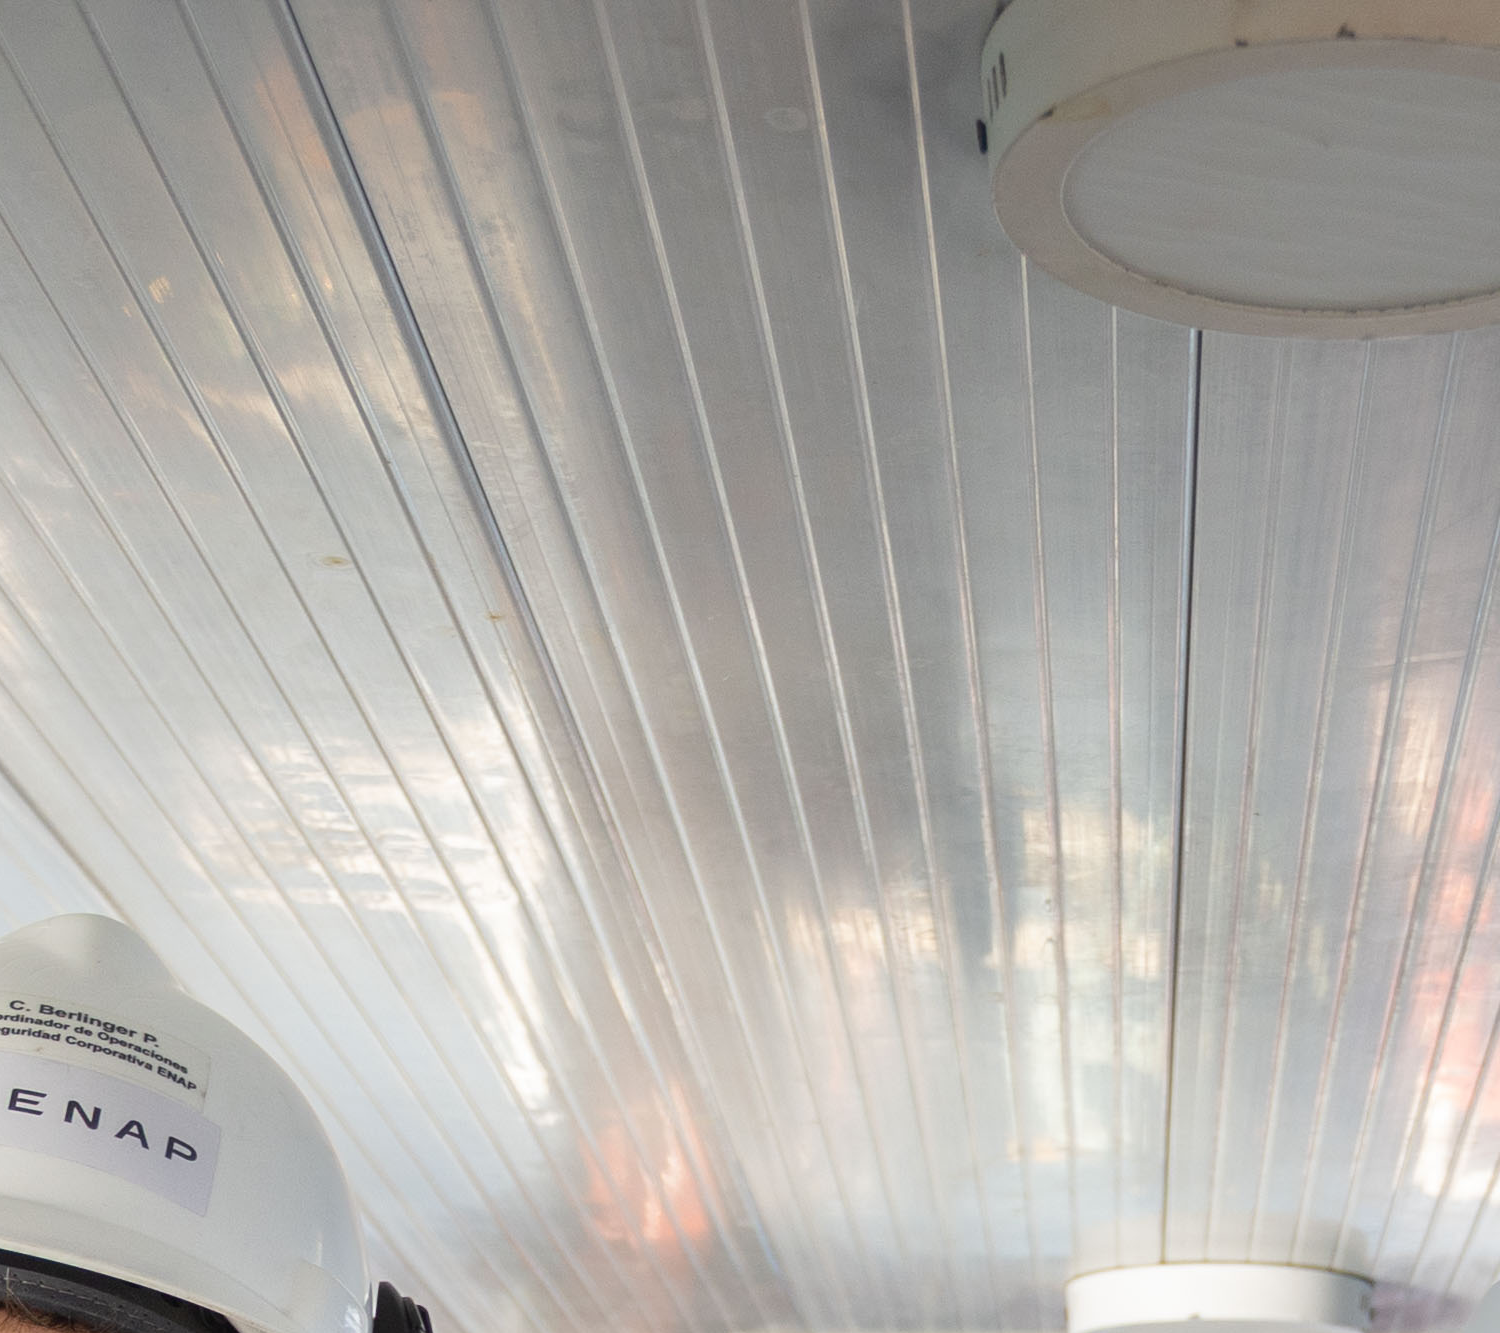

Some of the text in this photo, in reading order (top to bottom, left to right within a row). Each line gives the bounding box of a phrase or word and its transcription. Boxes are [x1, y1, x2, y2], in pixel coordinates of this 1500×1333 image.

[9, 999, 160, 1049] C. Berlinger P.
[74, 1026, 94, 1037] de
[97, 1031, 188, 1075] Operaciones
[65, 1036, 153, 1073] Corporativa
[157, 1066, 197, 1093] ENAP
[7, 1087, 198, 1164] ENAP
